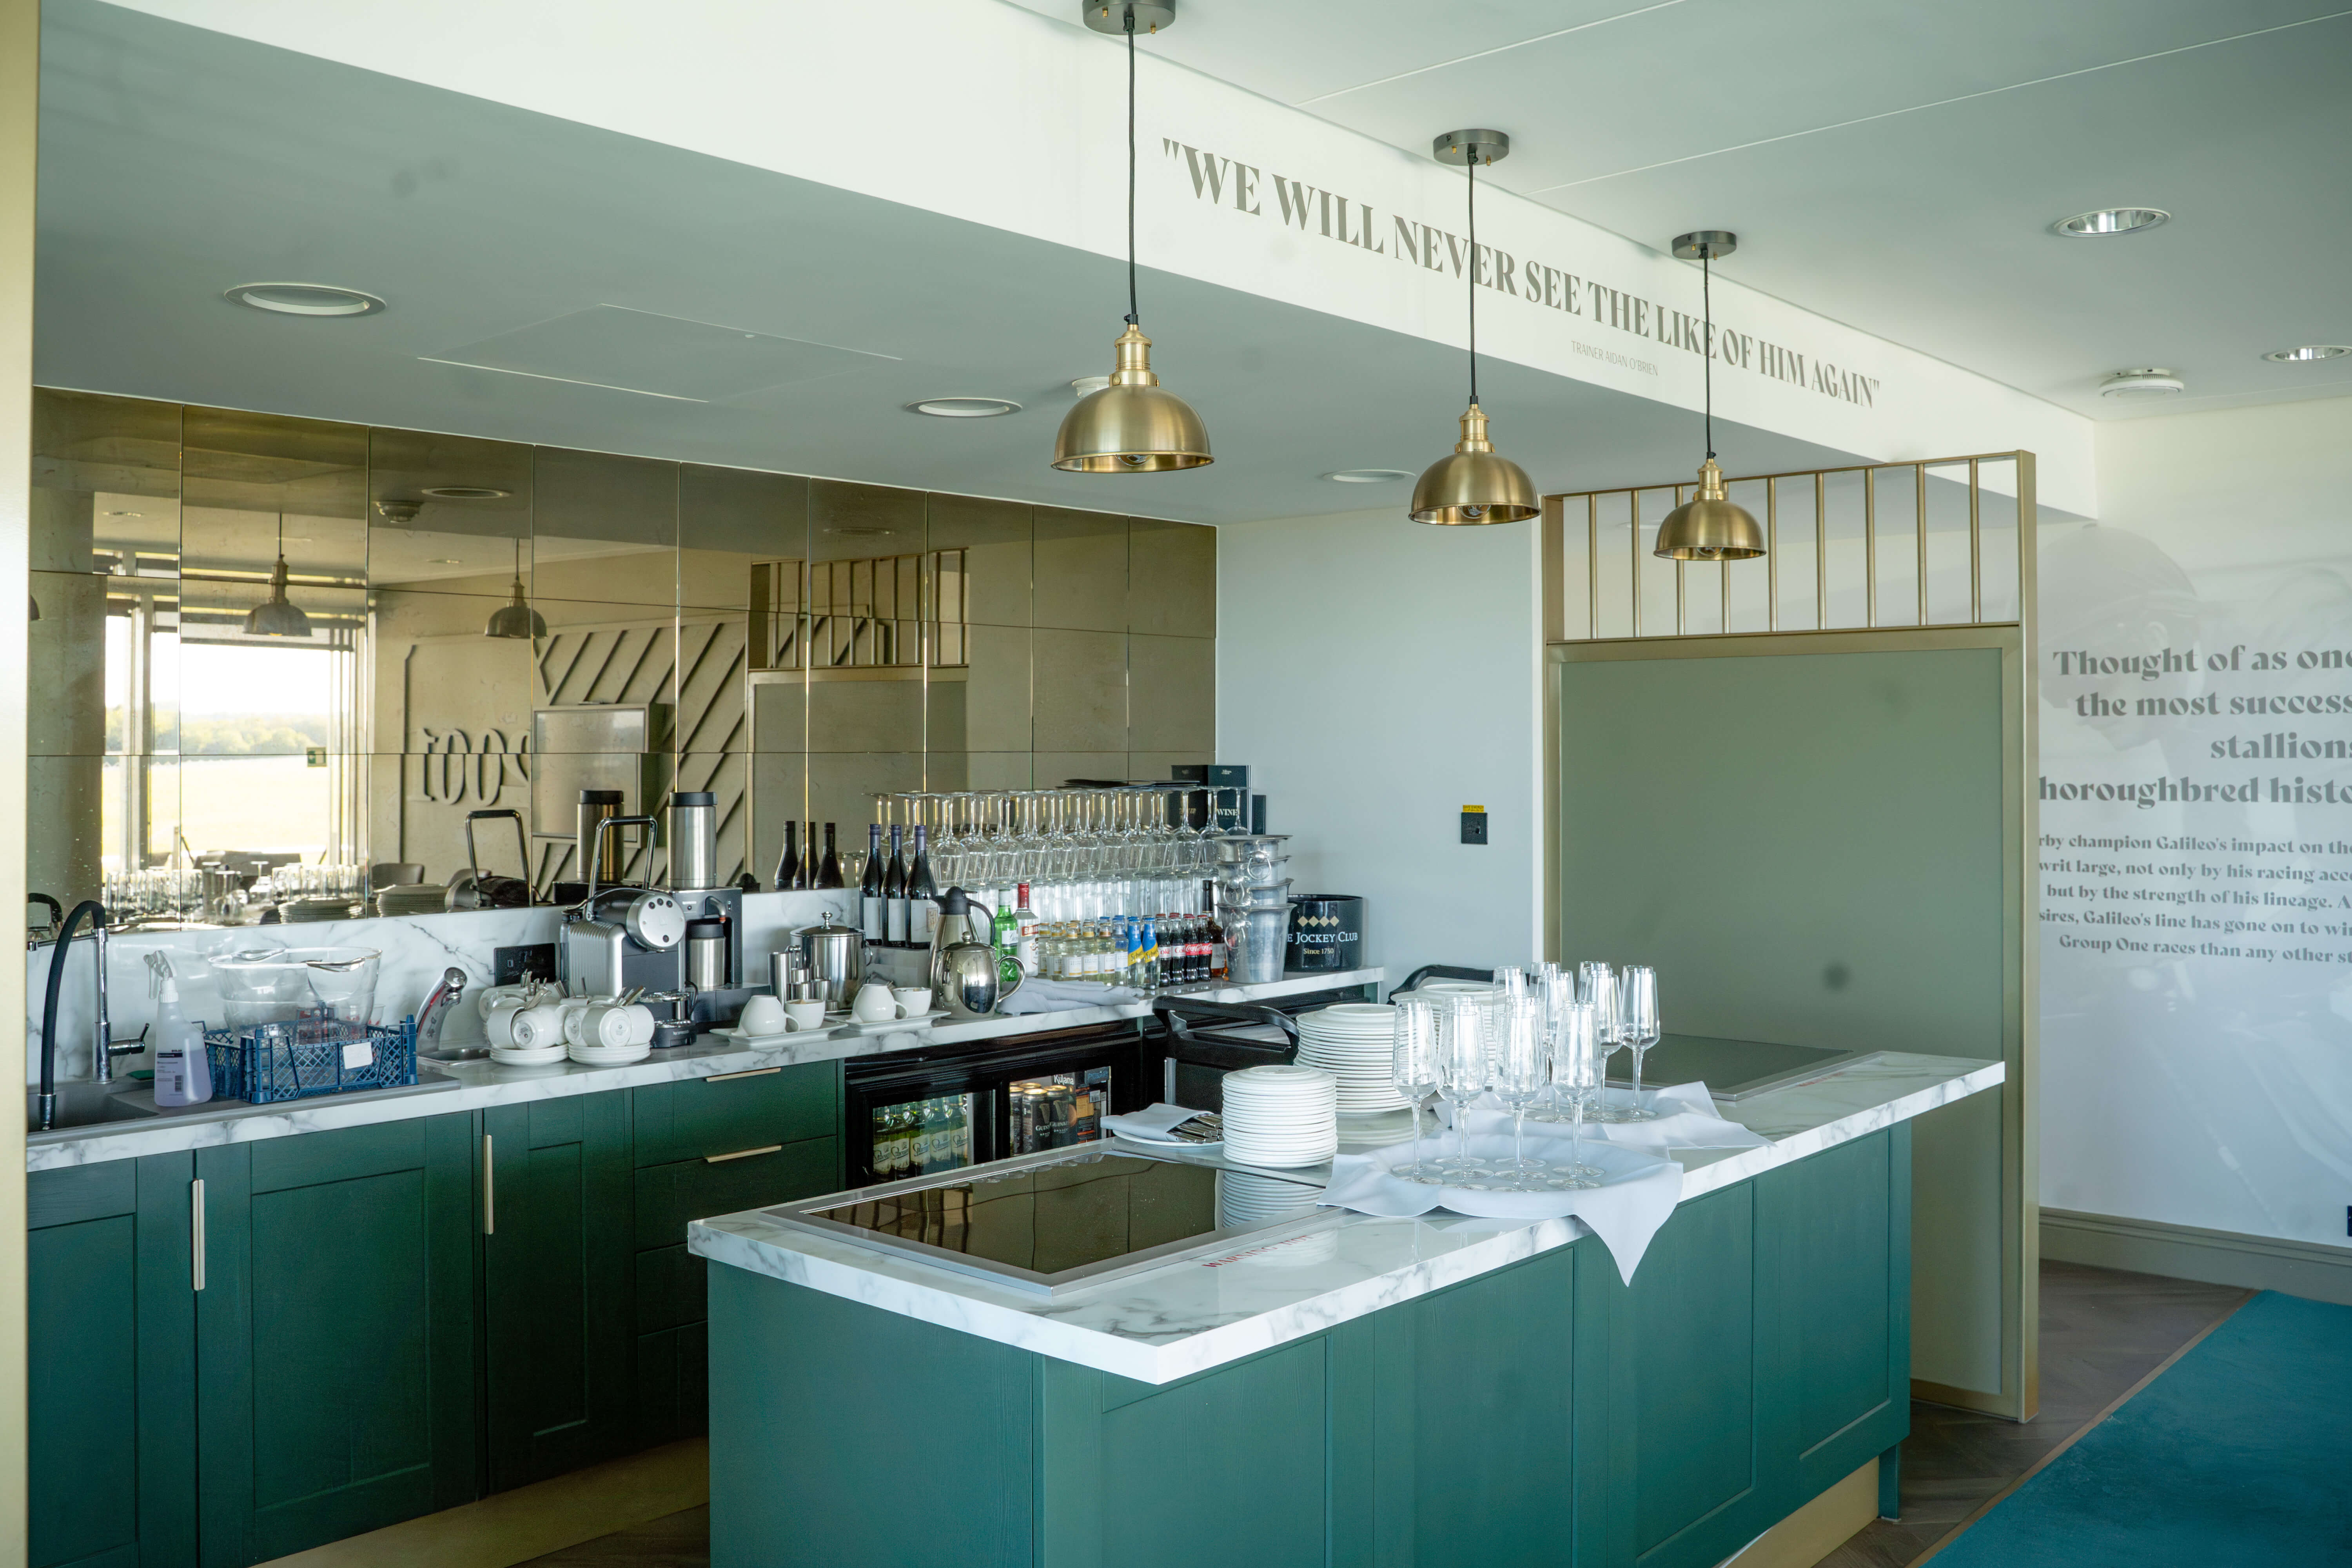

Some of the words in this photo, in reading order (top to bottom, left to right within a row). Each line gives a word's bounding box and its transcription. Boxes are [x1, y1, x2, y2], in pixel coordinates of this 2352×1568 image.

[1163, 137, 1260, 216] "WE
[1271, 173, 1384, 254] WILL
[1392, 214, 1519, 296] NEVER
[1526, 260, 1581, 316] SEE
[1588, 281, 1649, 338] THE
[1656, 304, 1717, 359] LIKE
[1722, 329, 1753, 370] OF
[1758, 340, 1807, 388] HIM
[1811, 359, 1879, 408] AGAIN"
[1571, 341, 1603, 361] TRAINER
[1606, 351, 1628, 367] AIDAN
[2053, 648, 2198, 681] Thought
[2207, 645, 2245, 671] of
[2251, 651, 2287, 670] as
[2076, 692, 2127, 717] the
[2136, 691, 2220, 716] most
[2230, 695, 2352, 715] success
[2210, 732, 2352, 759] stallion
[2069, 835, 2152, 852] champion
[2156, 836, 2227, 851] Galileo's
[2232, 838, 2294, 856] impact
[2299, 843, 2323, 853] on
[2039, 859, 2072, 872] writ
[2076, 860, 2121, 877] large,
[2126, 863, 2154, 875] not
[2159, 863, 2196, 879] only
[2201, 864, 2222, 880] by
[2227, 864, 2253, 878] his
[2257, 866, 2315, 884] racing
[2047, 884, 2074, 897] but
[2078, 885, 2098, 901] by
[2103, 886, 2129, 899] the
[2133, 889, 2205, 906] strength
[2210, 890, 2230, 903] of
[2233, 891, 2259, 905] his
[2263, 892, 2332, 912] lineage.
[2039, 909, 2079, 924] sires,
[2083, 910, 2151, 926] Galileo's
[2156, 914, 2186, 927] line
[2191, 915, 2220, 929] has
[2224, 920, 2267, 934] gone
[2271, 923, 2294, 933] on
[2300, 922, 2319, 934] to
[1296, 932, 1336, 945] JOCKEY
[1338, 931, 1358, 942] CLUB
[2059, 935, 2112, 953] Group
[2116, 938, 2149, 951] One
[2153, 943, 2196, 954] races
[2201, 942, 2240, 956] than
[2245, 948, 2277, 962] any
[2282, 947, 2333, 962] other
[1201, 1246, 1278, 1267] WARNING
